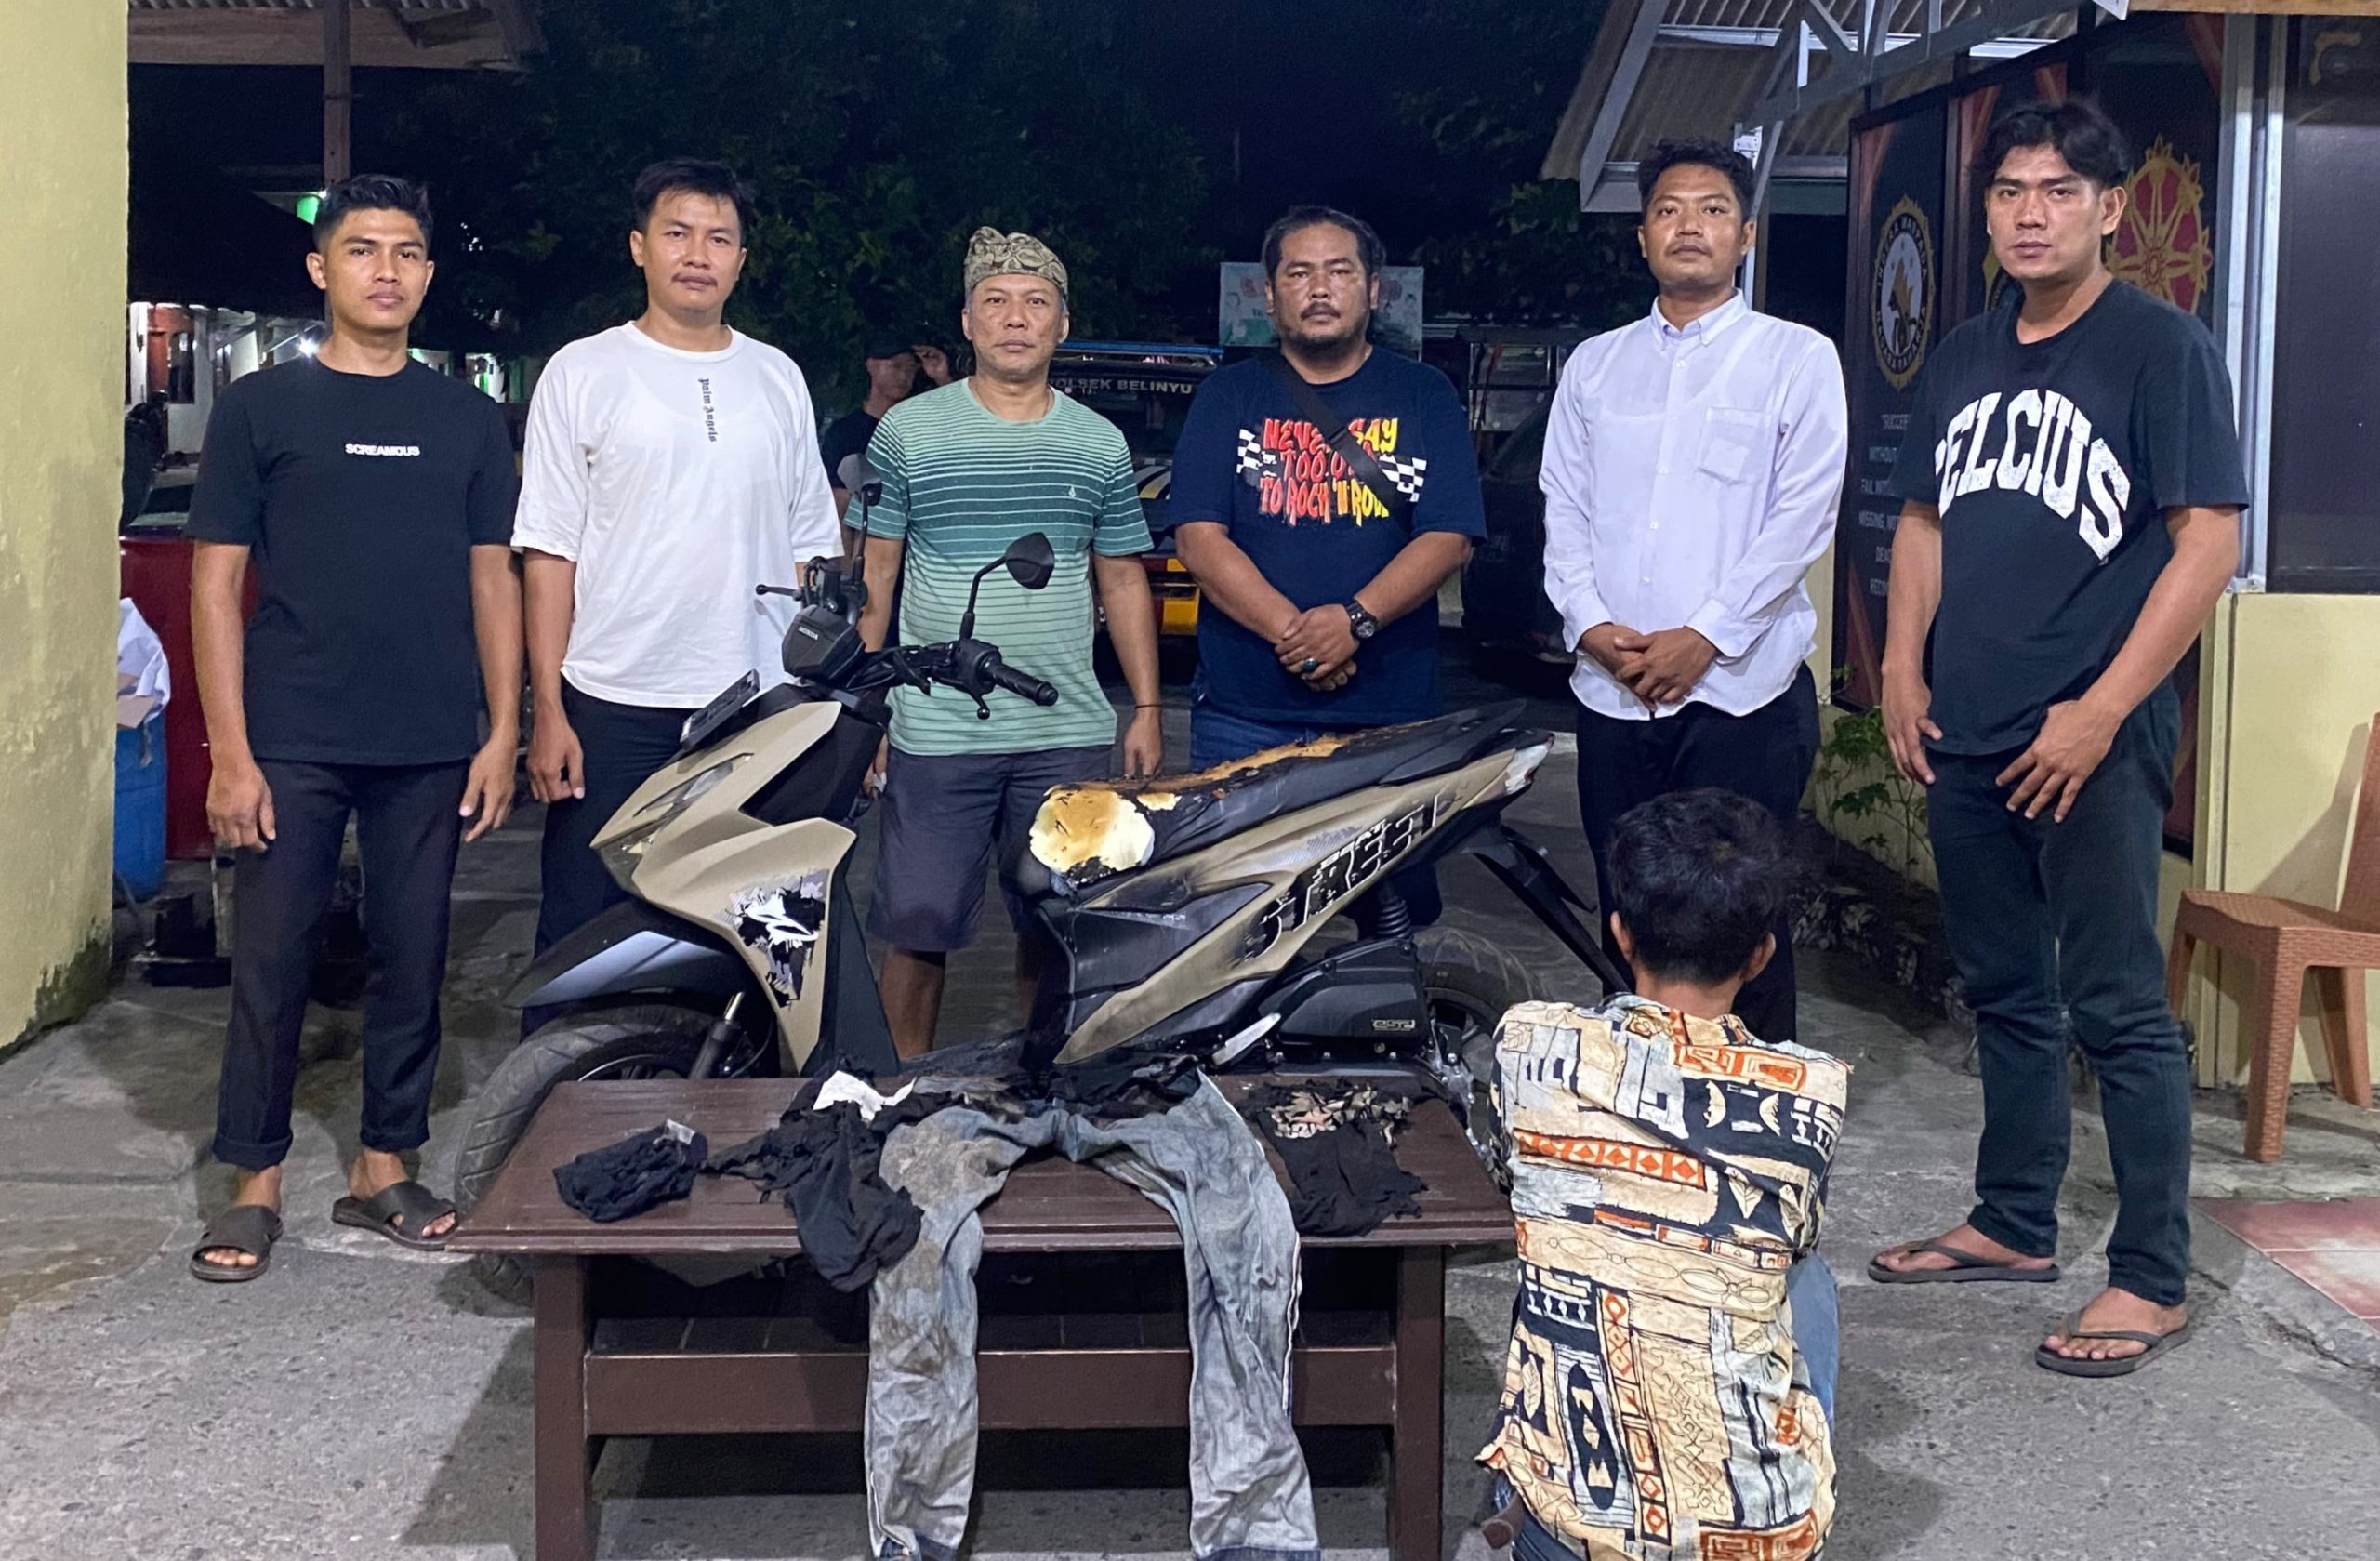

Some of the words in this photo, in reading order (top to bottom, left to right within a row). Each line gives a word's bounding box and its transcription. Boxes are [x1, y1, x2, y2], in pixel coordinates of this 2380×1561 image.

[1117, 379, 1193, 394] BELINYU
[703, 405, 718, 443] Angels
[1263, 417, 1331, 456] NEVE
[1347, 417, 1398, 454] SAY
[345, 443, 421, 456] SCREAMOUS
[1279, 448, 1327, 483] TOO
[1259, 476, 1283, 515] TO
[1286, 477, 1331, 527] ROCK
